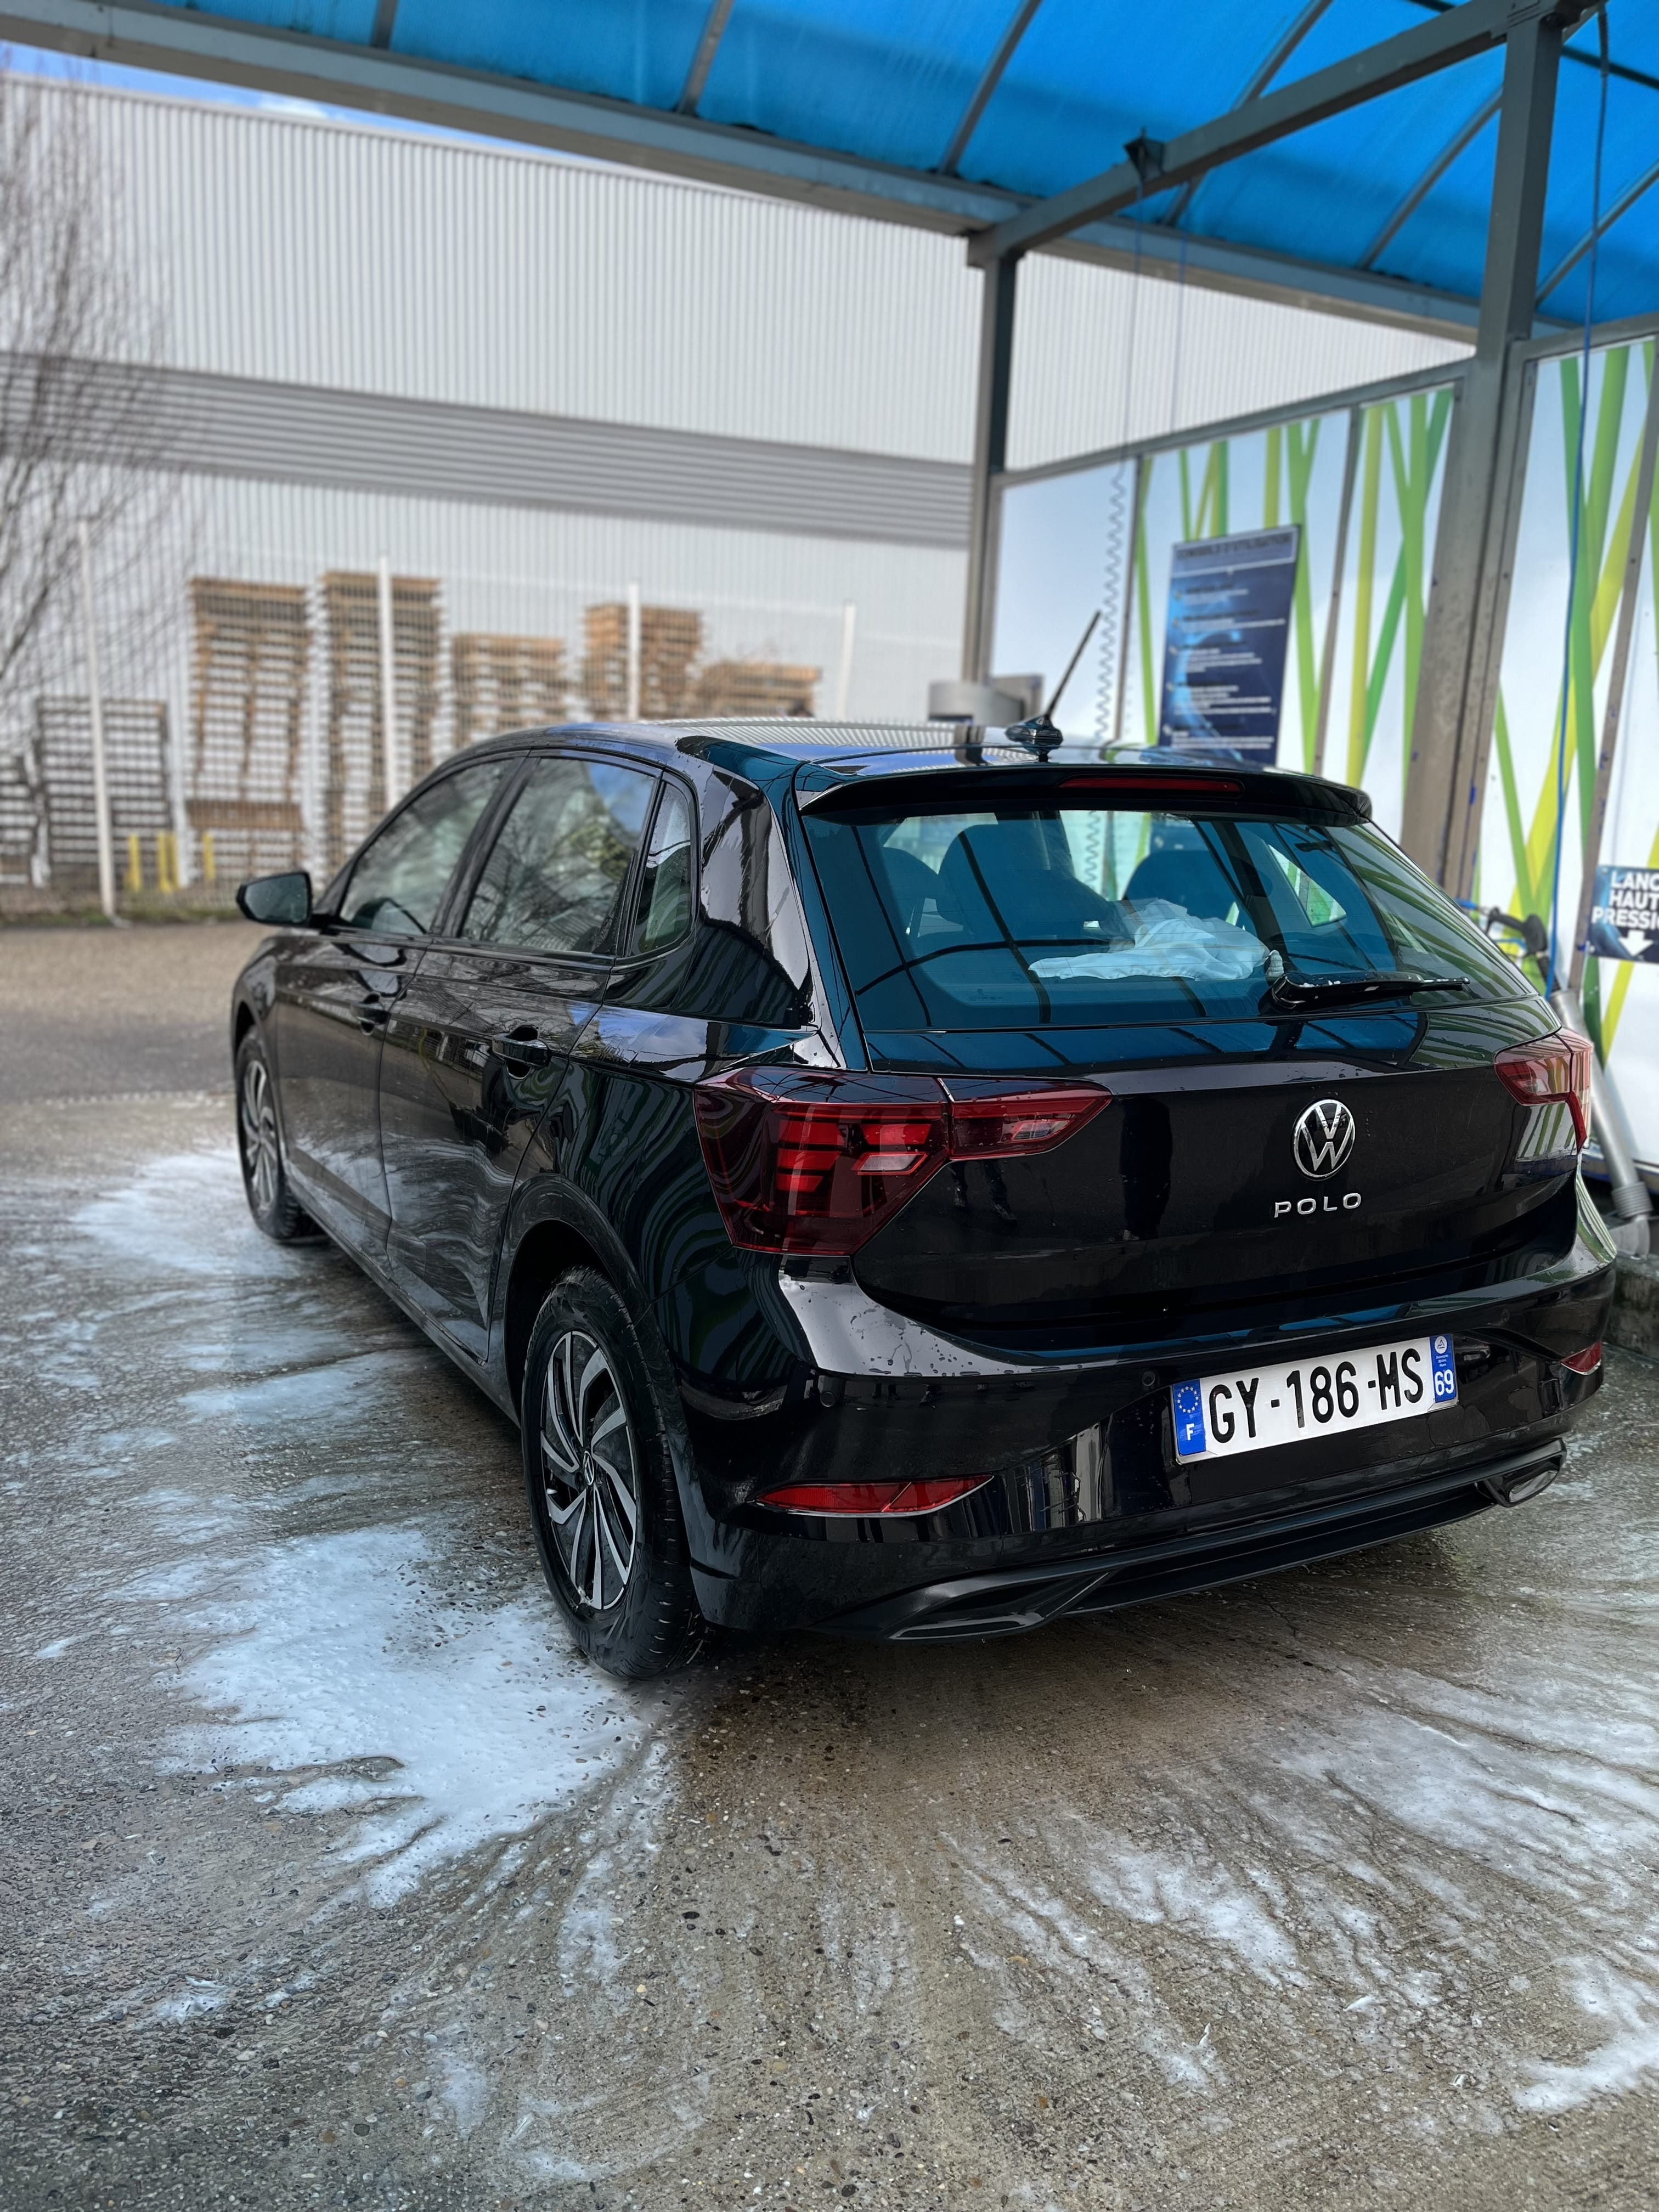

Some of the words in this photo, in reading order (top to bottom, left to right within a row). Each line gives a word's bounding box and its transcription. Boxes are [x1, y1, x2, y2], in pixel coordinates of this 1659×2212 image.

[1592, 906, 1659, 930] PRESSI
[1274, 1193, 1362, 1218] POLO
[1435, 1369, 1454, 1396] 69
[1209, 1348, 1424, 1443] GY-186-MS
[1186, 1423, 1195, 1441] F
